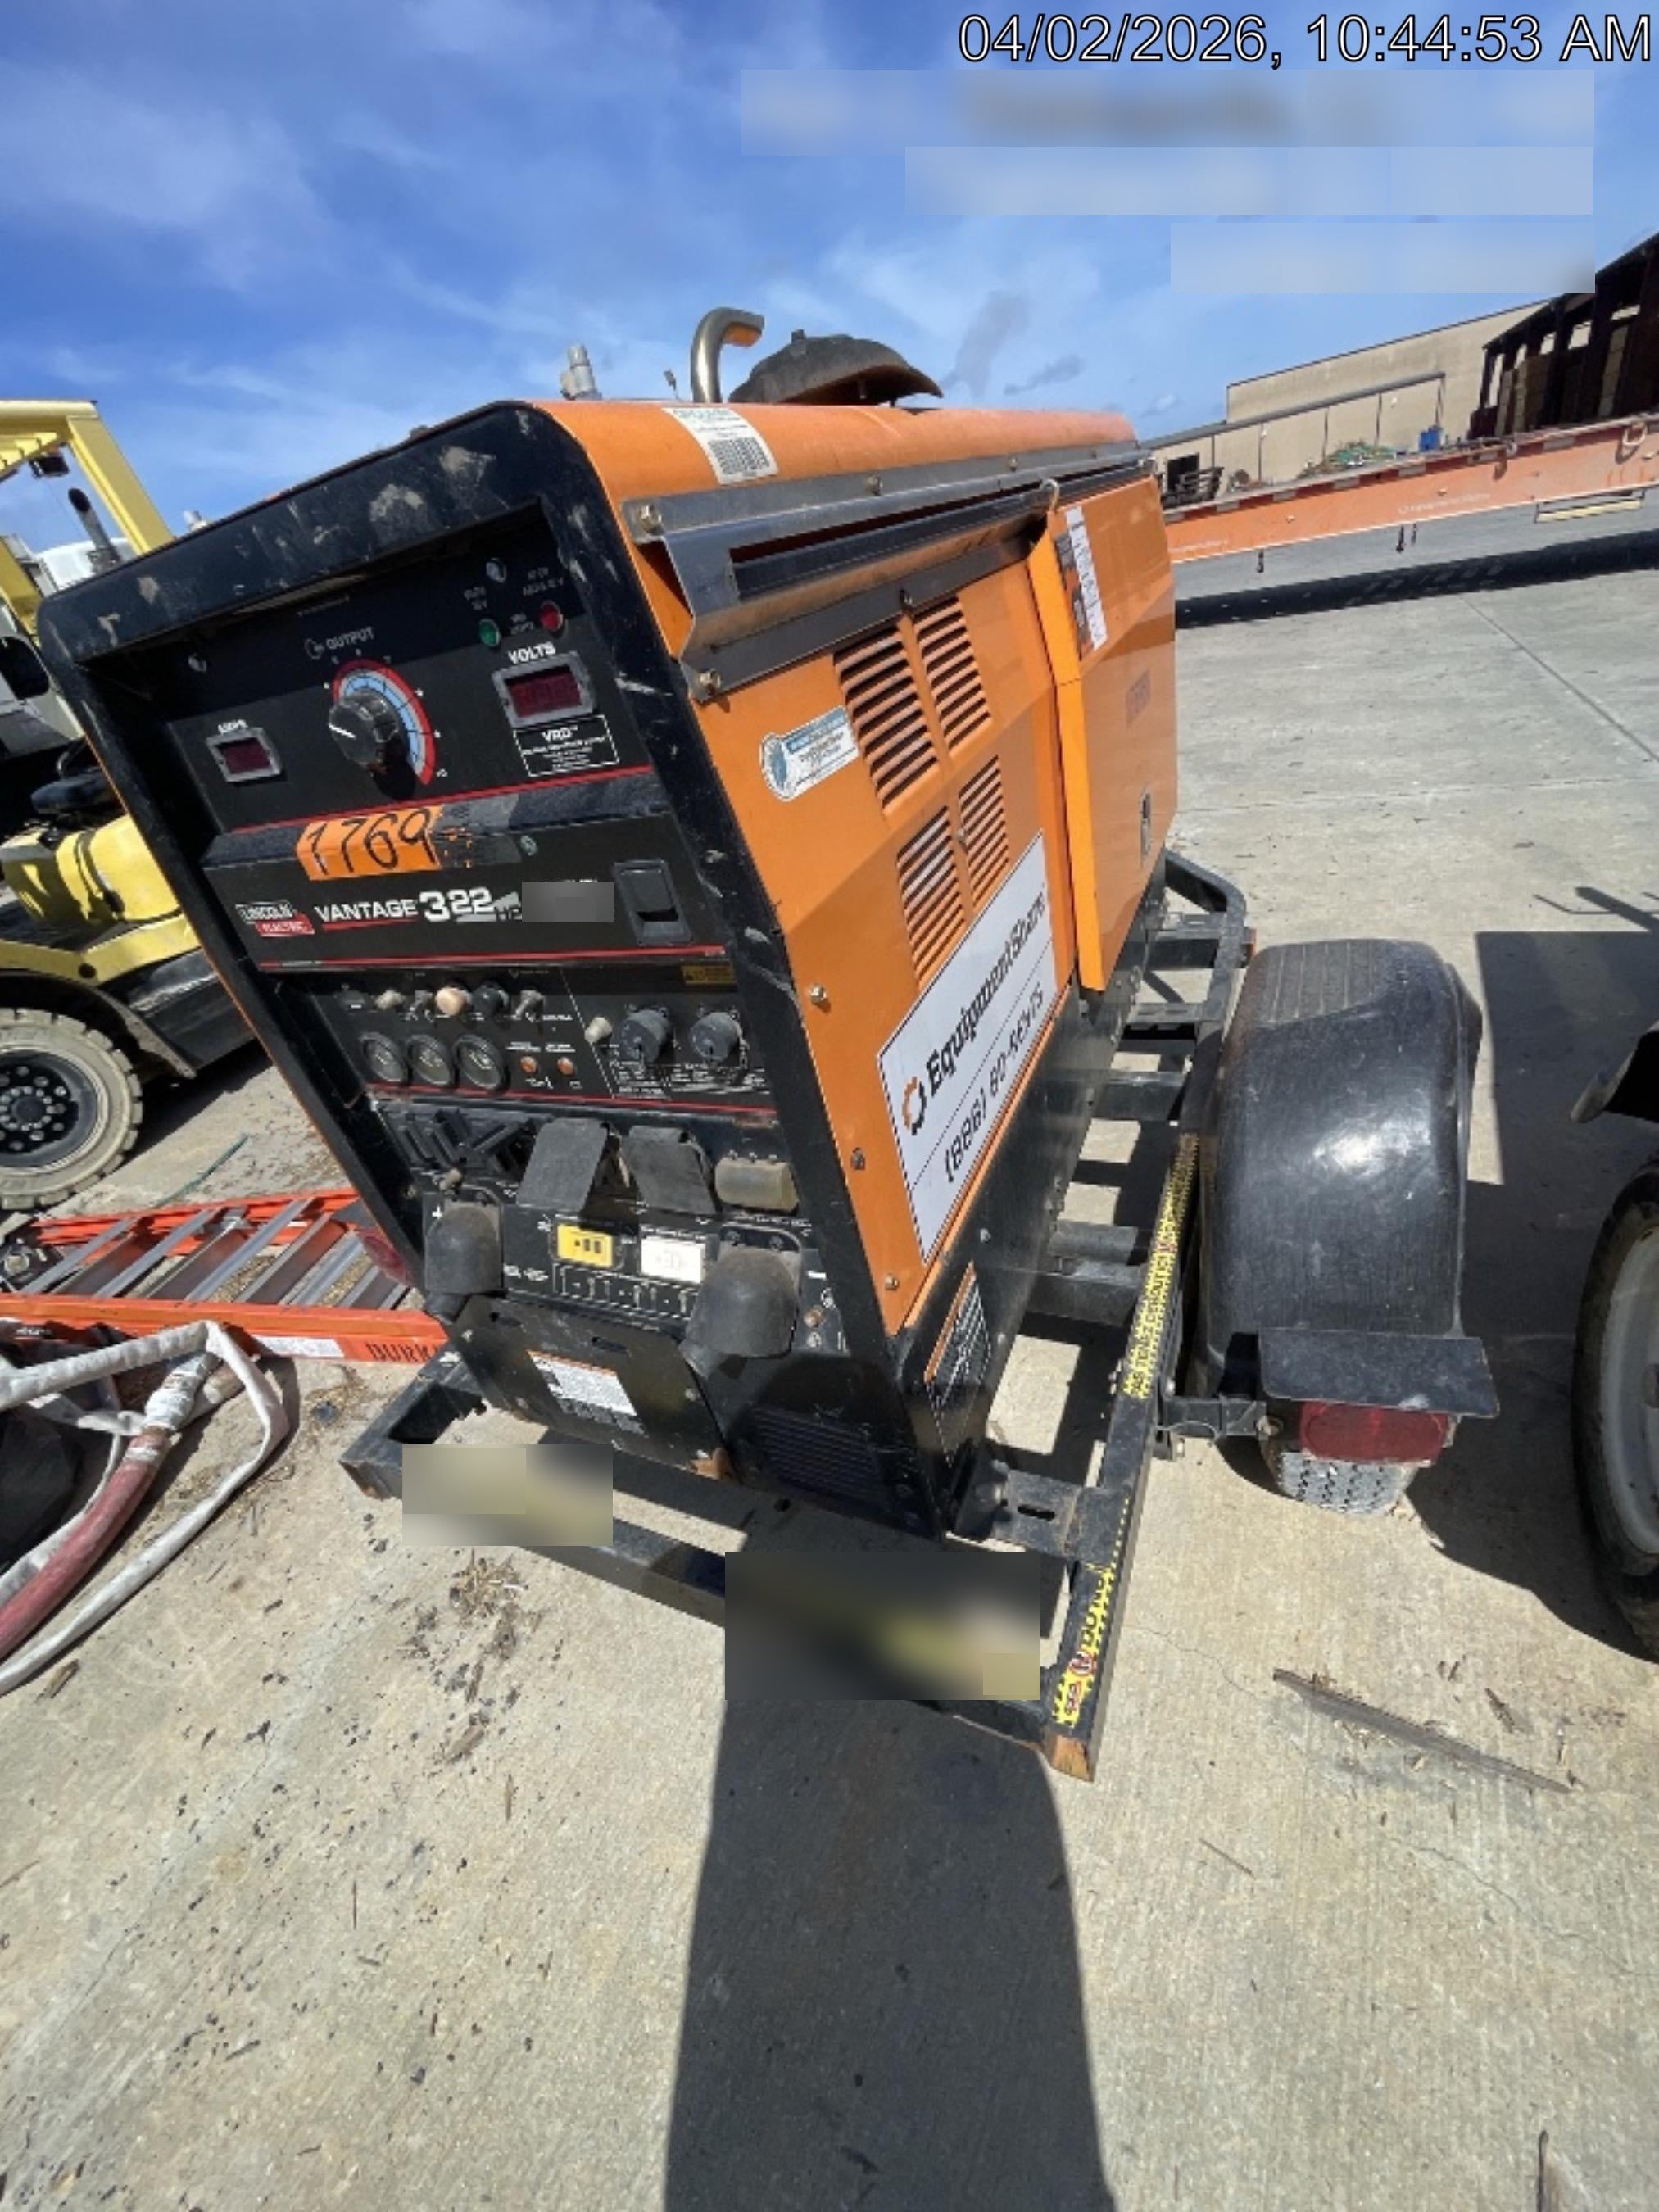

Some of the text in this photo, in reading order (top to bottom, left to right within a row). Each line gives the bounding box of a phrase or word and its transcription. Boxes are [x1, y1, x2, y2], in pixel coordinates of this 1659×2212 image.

[326, 626, 374, 650] OUTPUT
[508, 641, 556, 664] VOLTS
[313, 899, 418, 922] VANTAGE
[419, 886, 495, 923] 322
[925, 891, 1046, 1098] EquipmentShare
